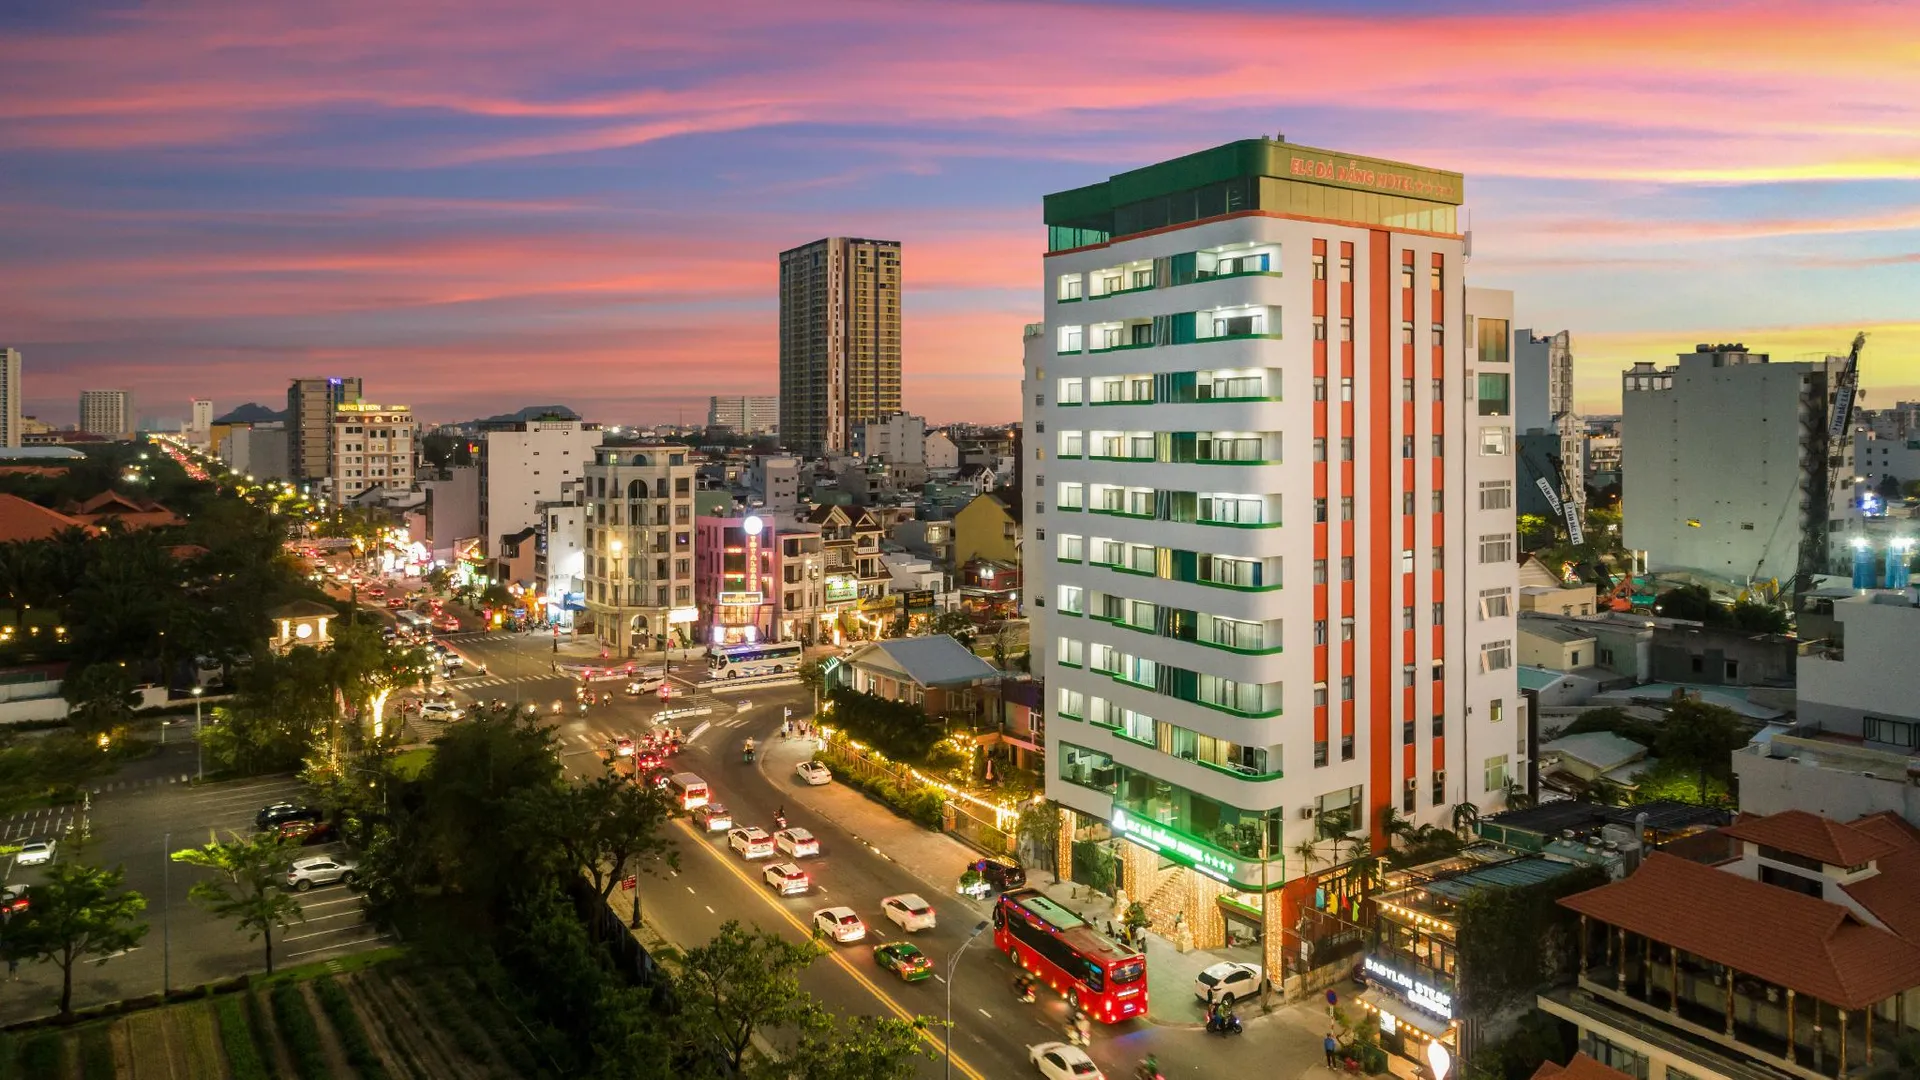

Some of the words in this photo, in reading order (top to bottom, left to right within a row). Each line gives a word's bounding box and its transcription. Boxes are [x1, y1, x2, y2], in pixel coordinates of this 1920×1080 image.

[1290, 156, 1314, 176] ELC
[1376, 172, 1414, 191] HOTEL
[1365, 958, 1413, 989] BABYLON
